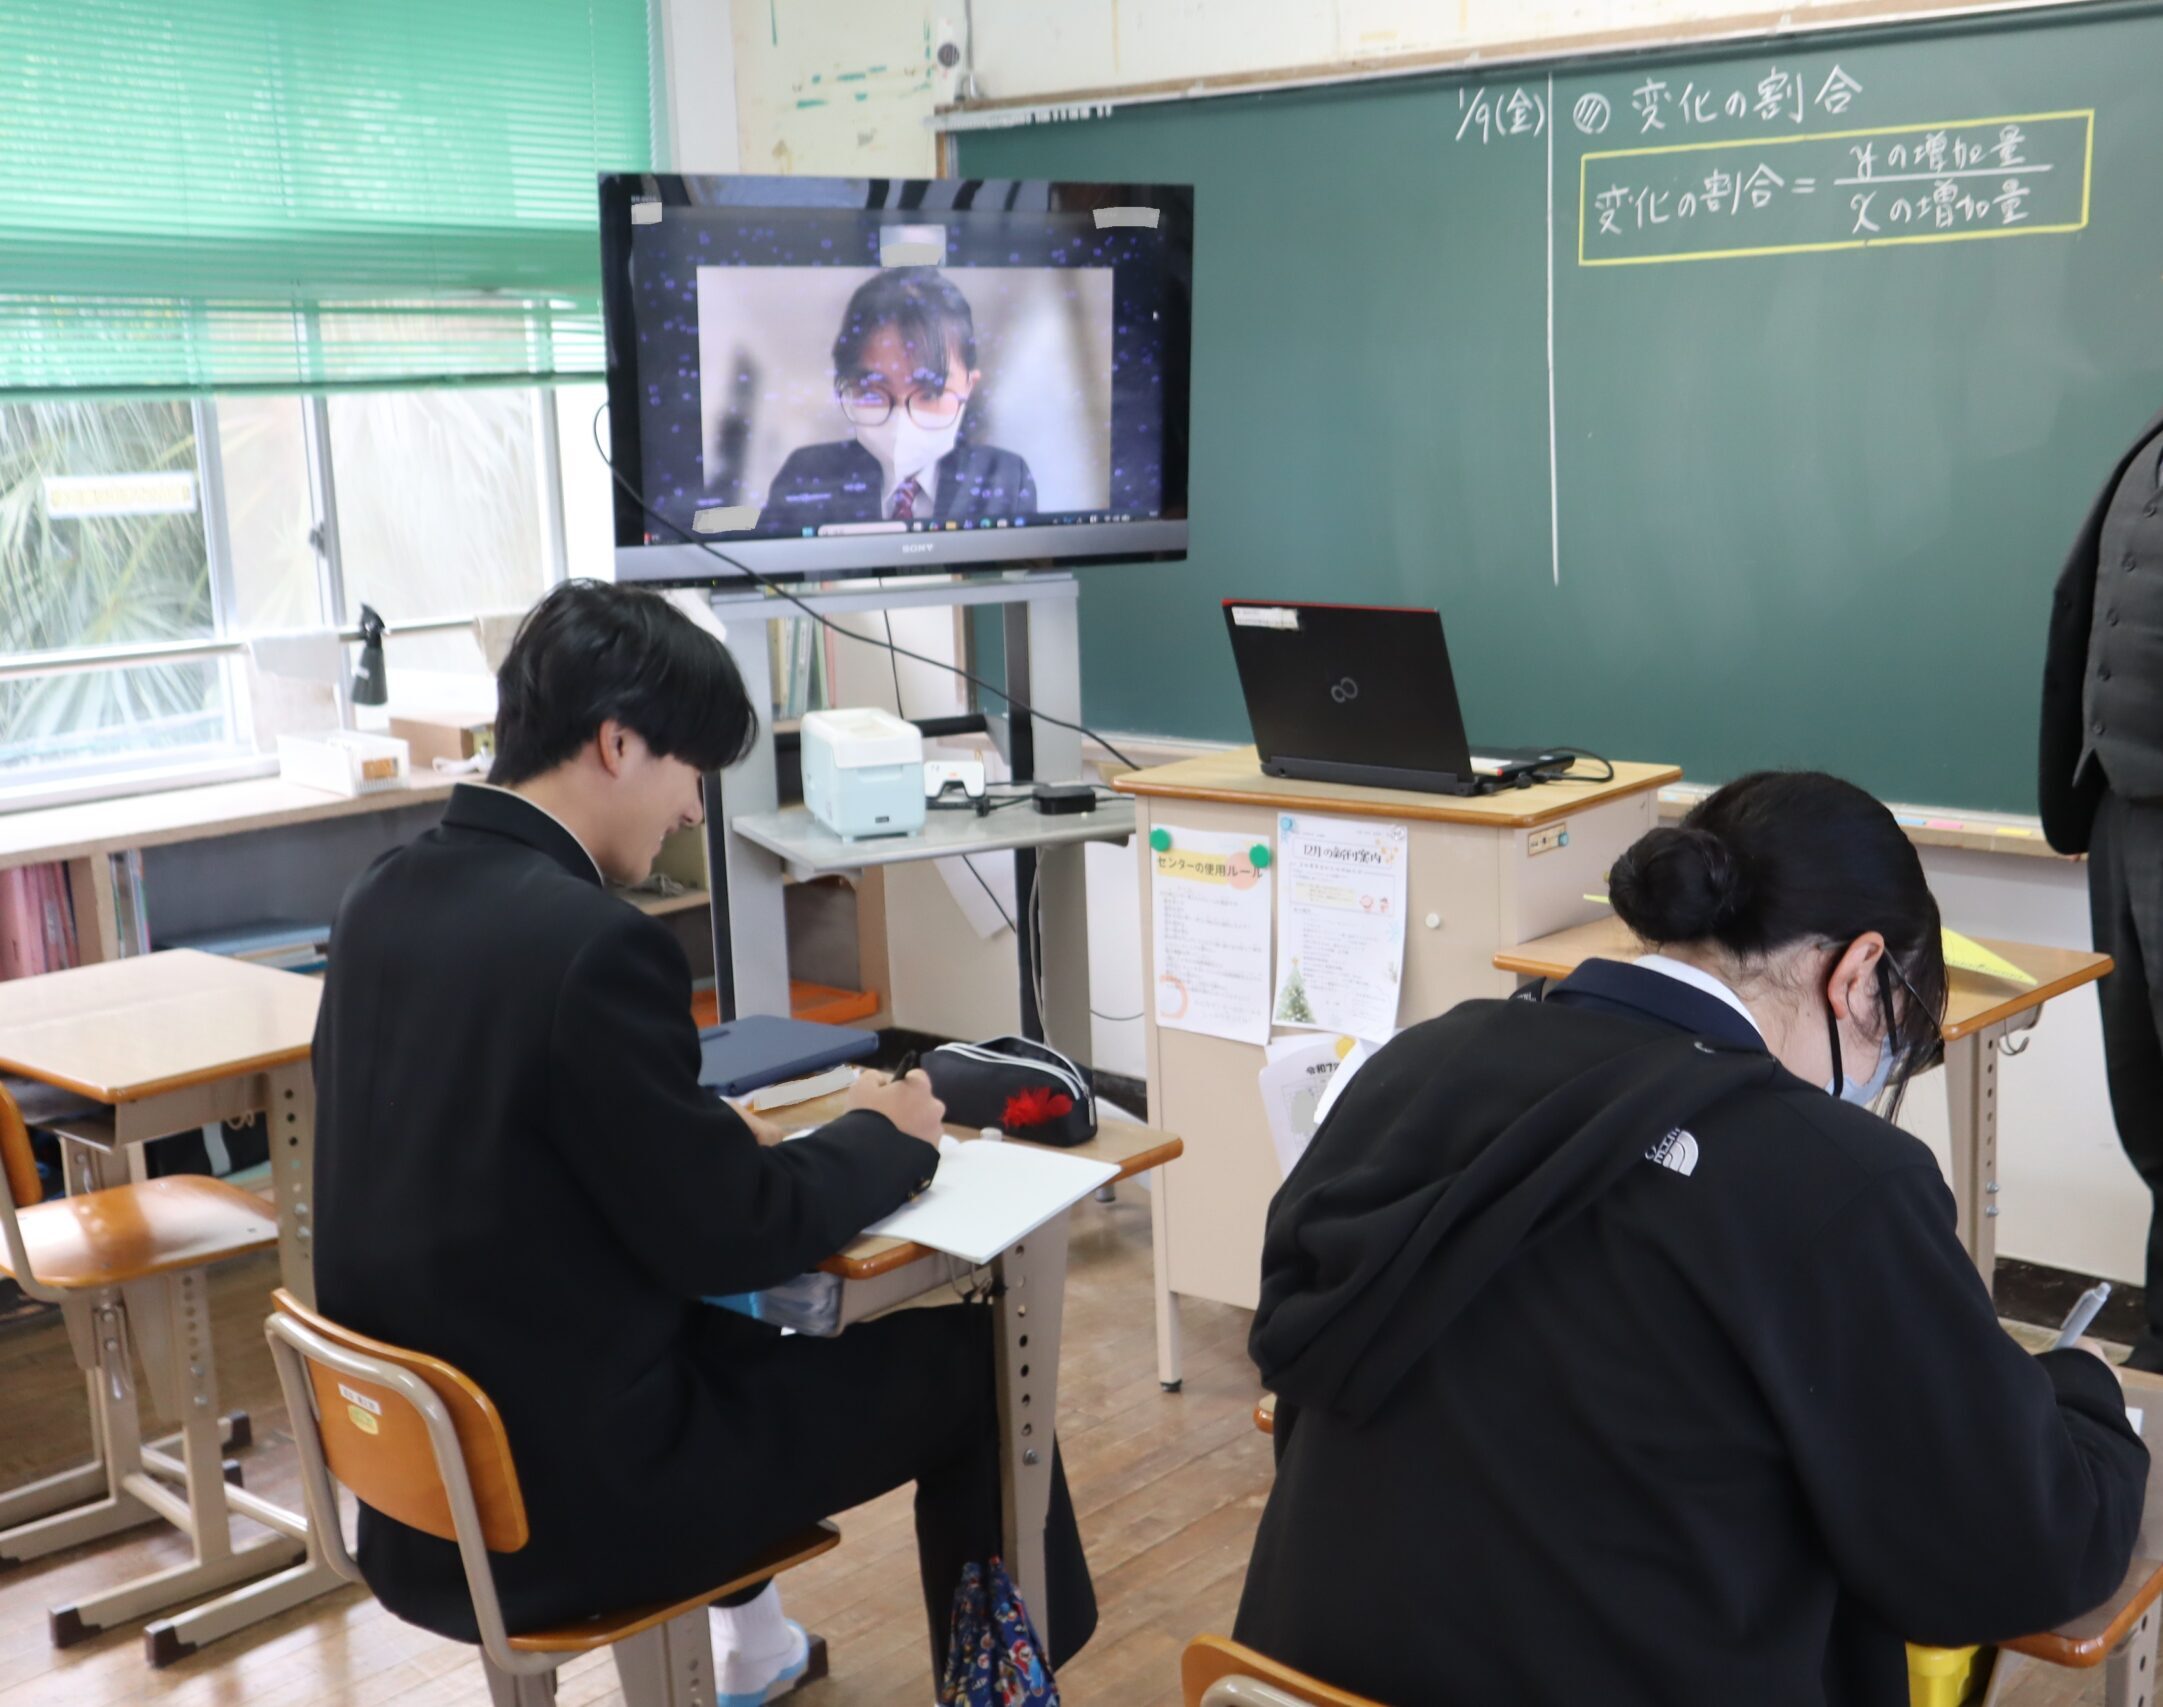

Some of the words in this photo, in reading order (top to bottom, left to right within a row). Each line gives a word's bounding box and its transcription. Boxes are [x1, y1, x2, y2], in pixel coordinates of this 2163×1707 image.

[1455, 86, 1546, 145] 1/9(金)
[1632, 64, 1863, 134] 変化の割合
